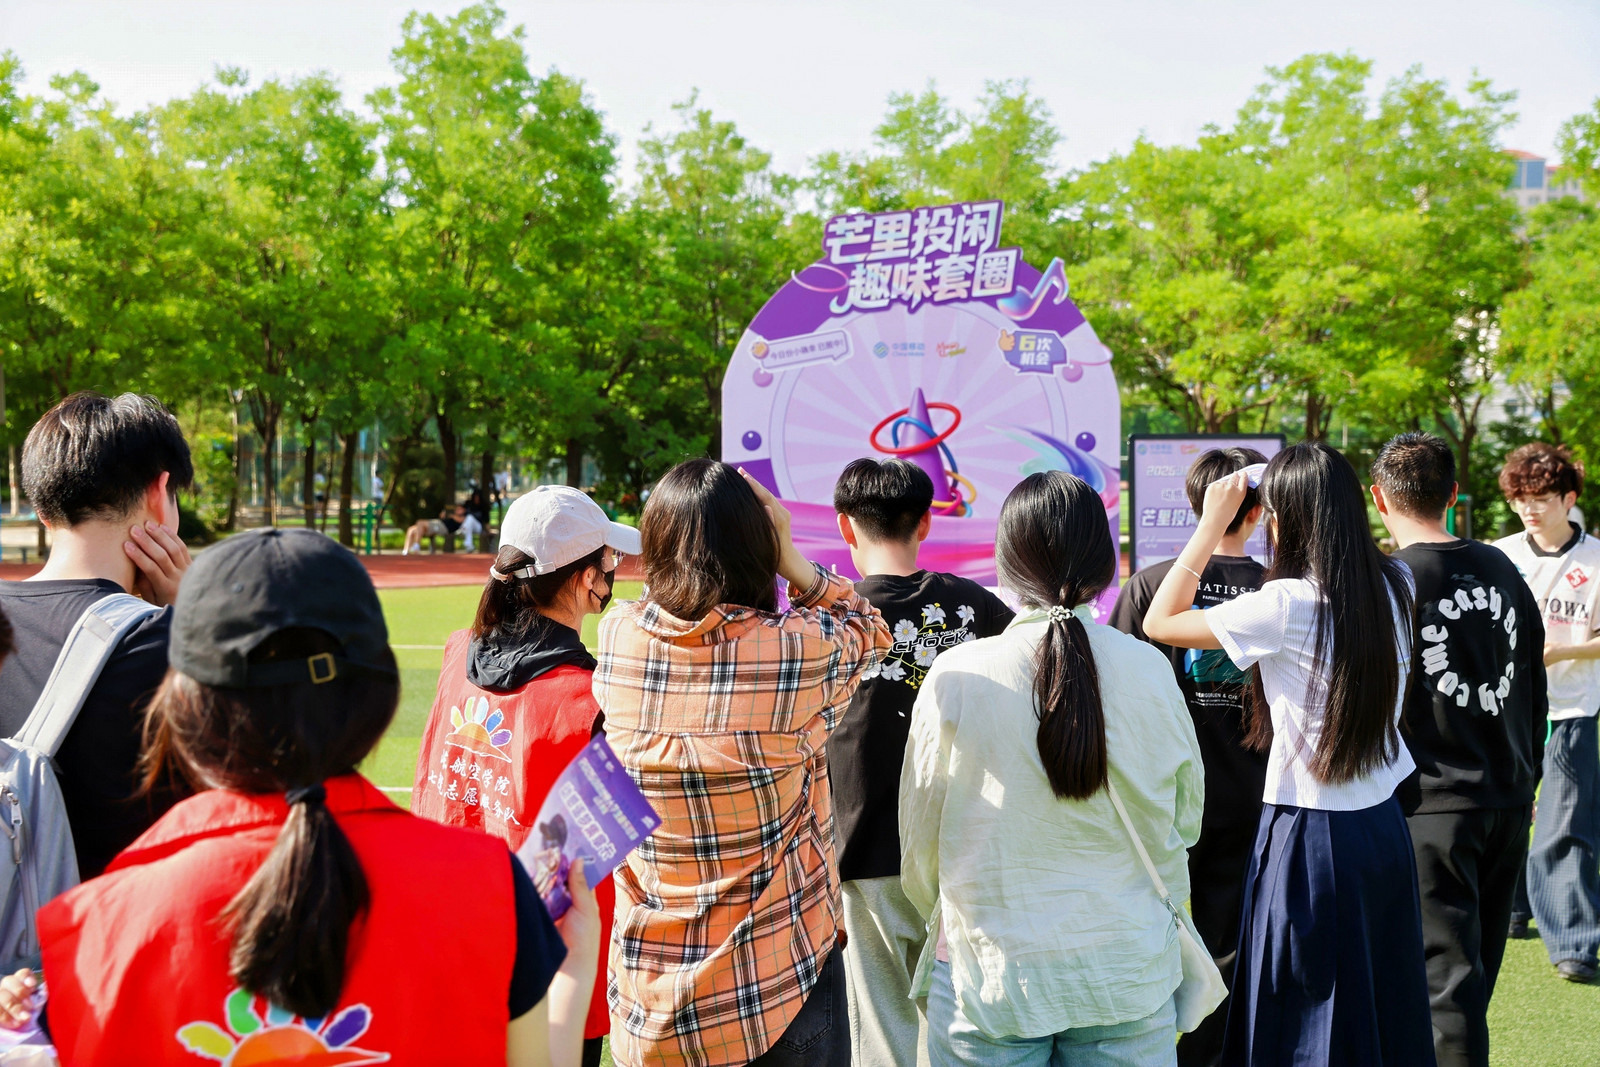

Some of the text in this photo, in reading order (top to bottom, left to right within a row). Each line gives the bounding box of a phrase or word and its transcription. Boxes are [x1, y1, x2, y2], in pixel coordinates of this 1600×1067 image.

[826, 202, 1000, 264] 芒里投闲
[830, 248, 1018, 314] 趣味套圈
[1019, 334, 1053, 351] 6次
[1020, 352, 1050, 365] 机会
[1198, 581, 1256, 595] ATISSE
[1438, 586, 1502, 620] easy
